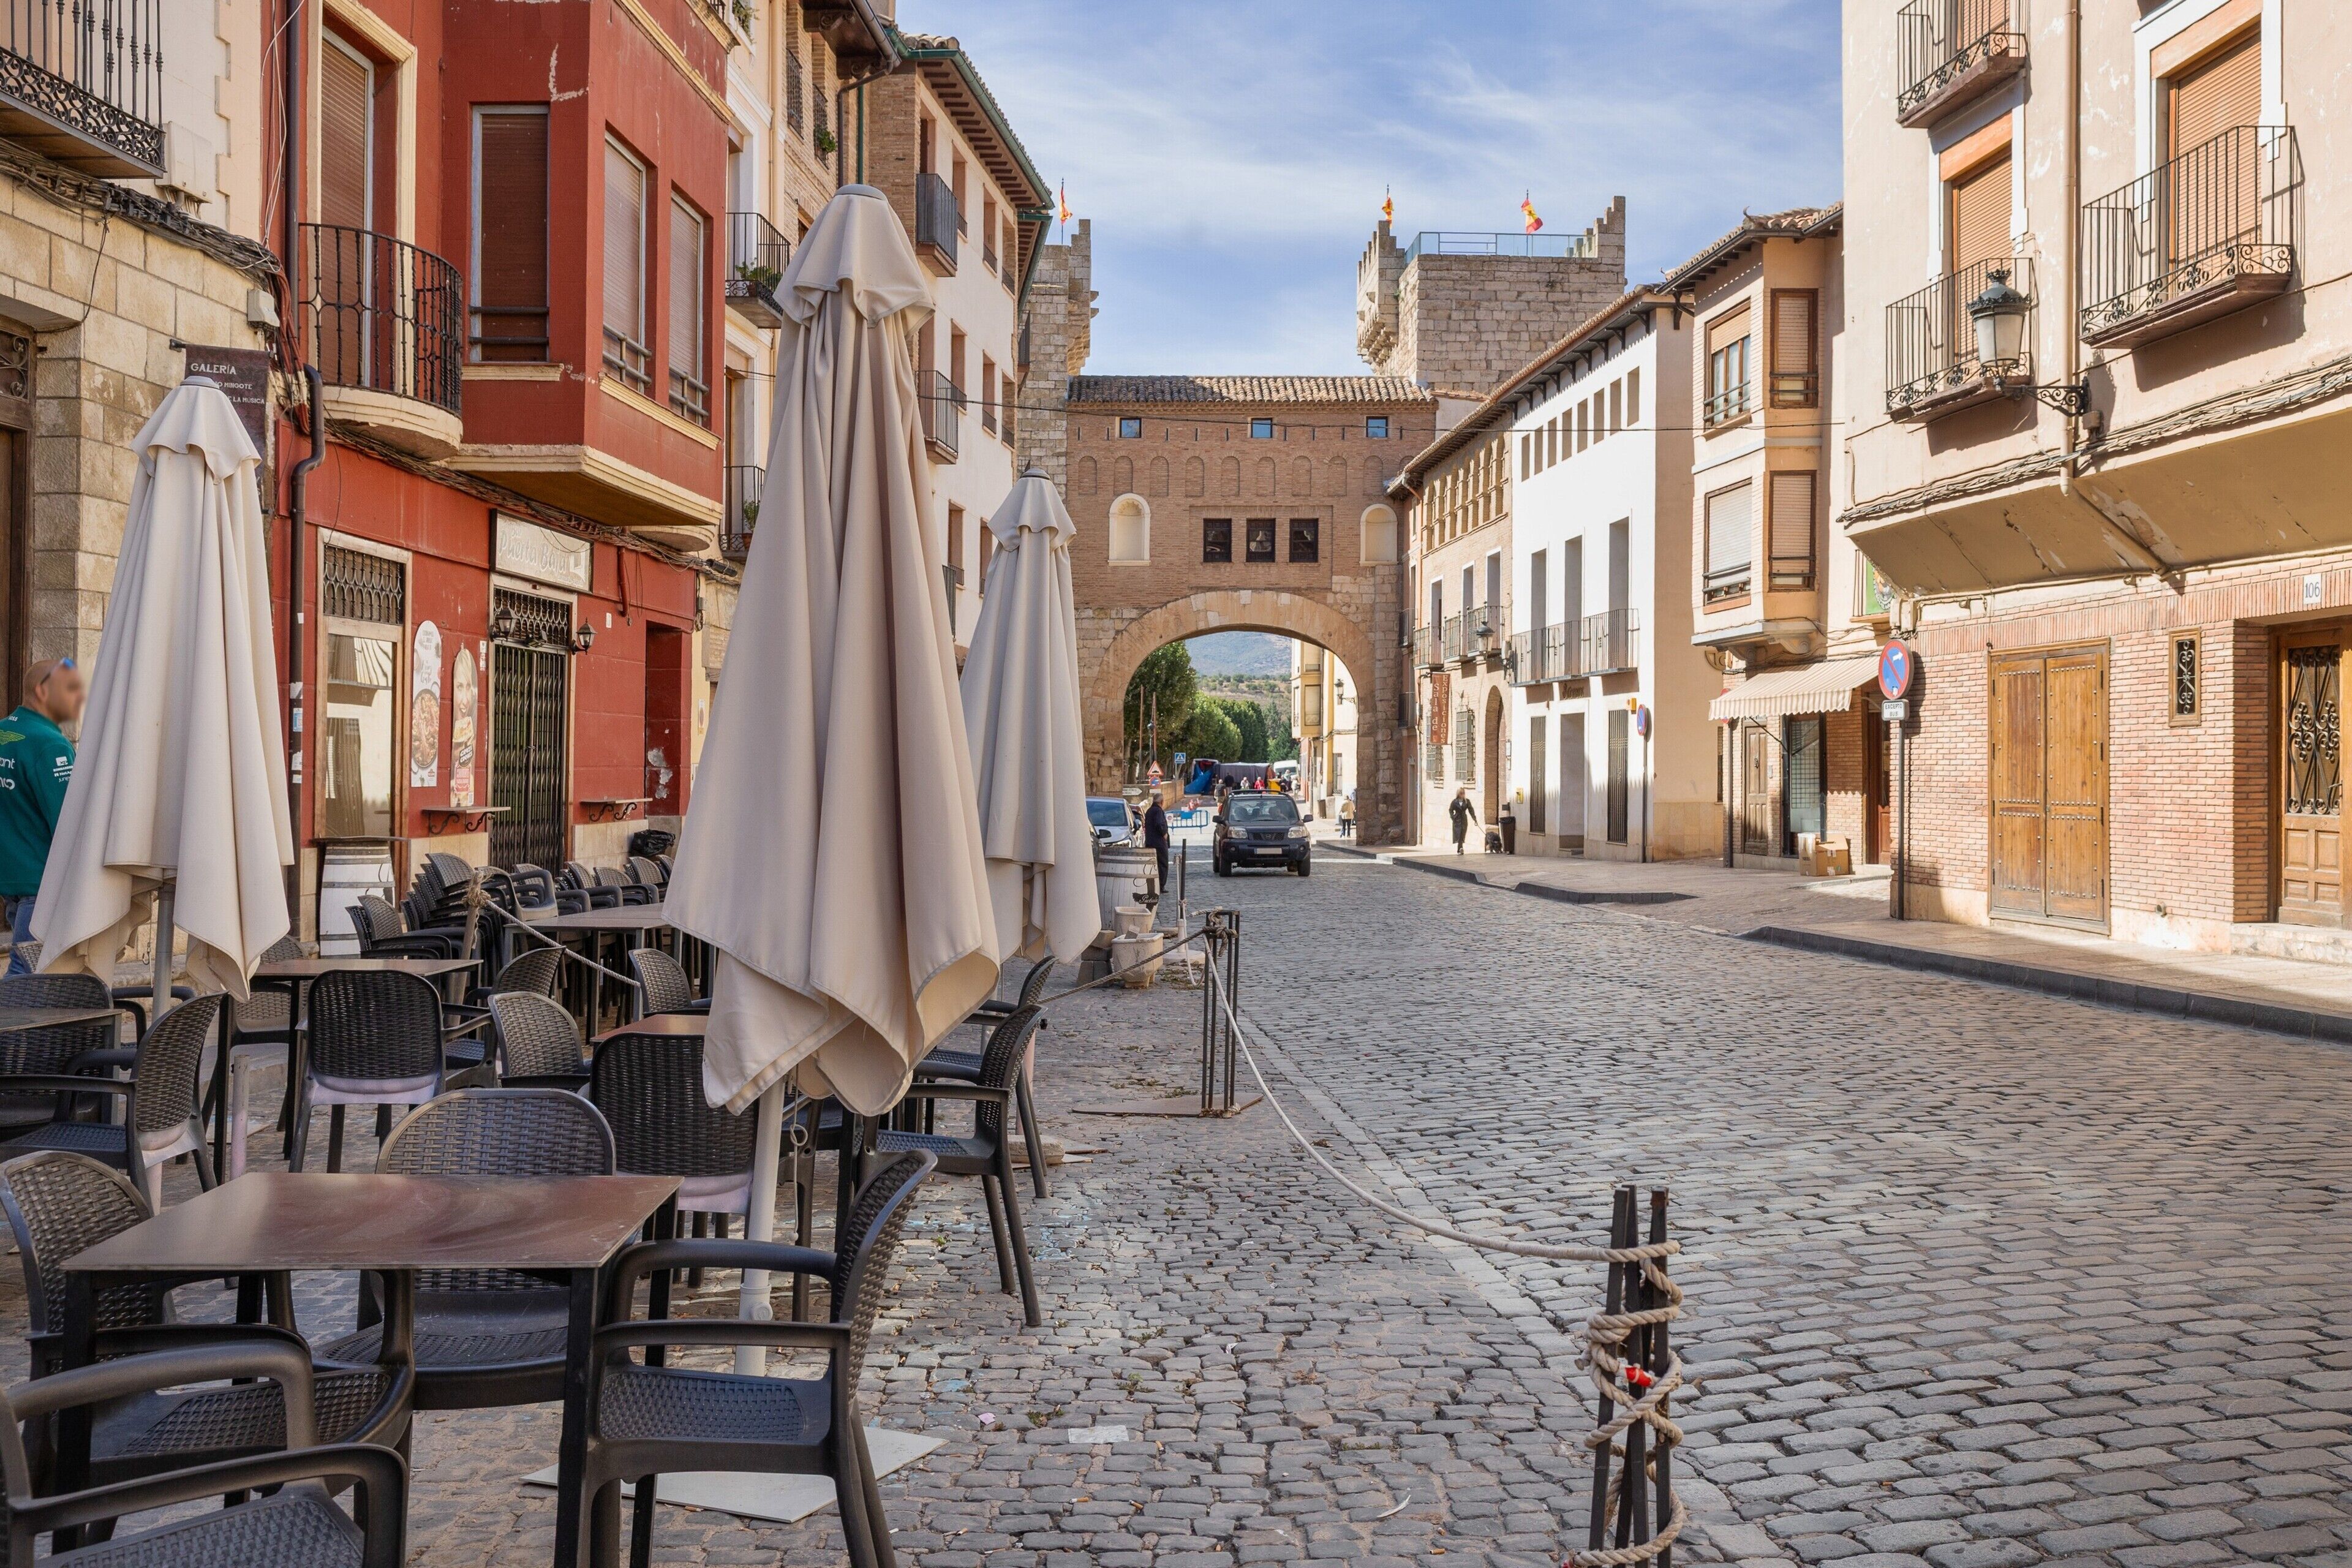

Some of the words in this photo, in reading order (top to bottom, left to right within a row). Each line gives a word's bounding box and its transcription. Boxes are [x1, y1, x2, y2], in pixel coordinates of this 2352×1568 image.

[190, 363, 236, 374] GALERÍA
[499, 530, 537, 566] Puerta
[2305, 582, 2320, 598] 106
[1432, 717, 1438, 731] de
